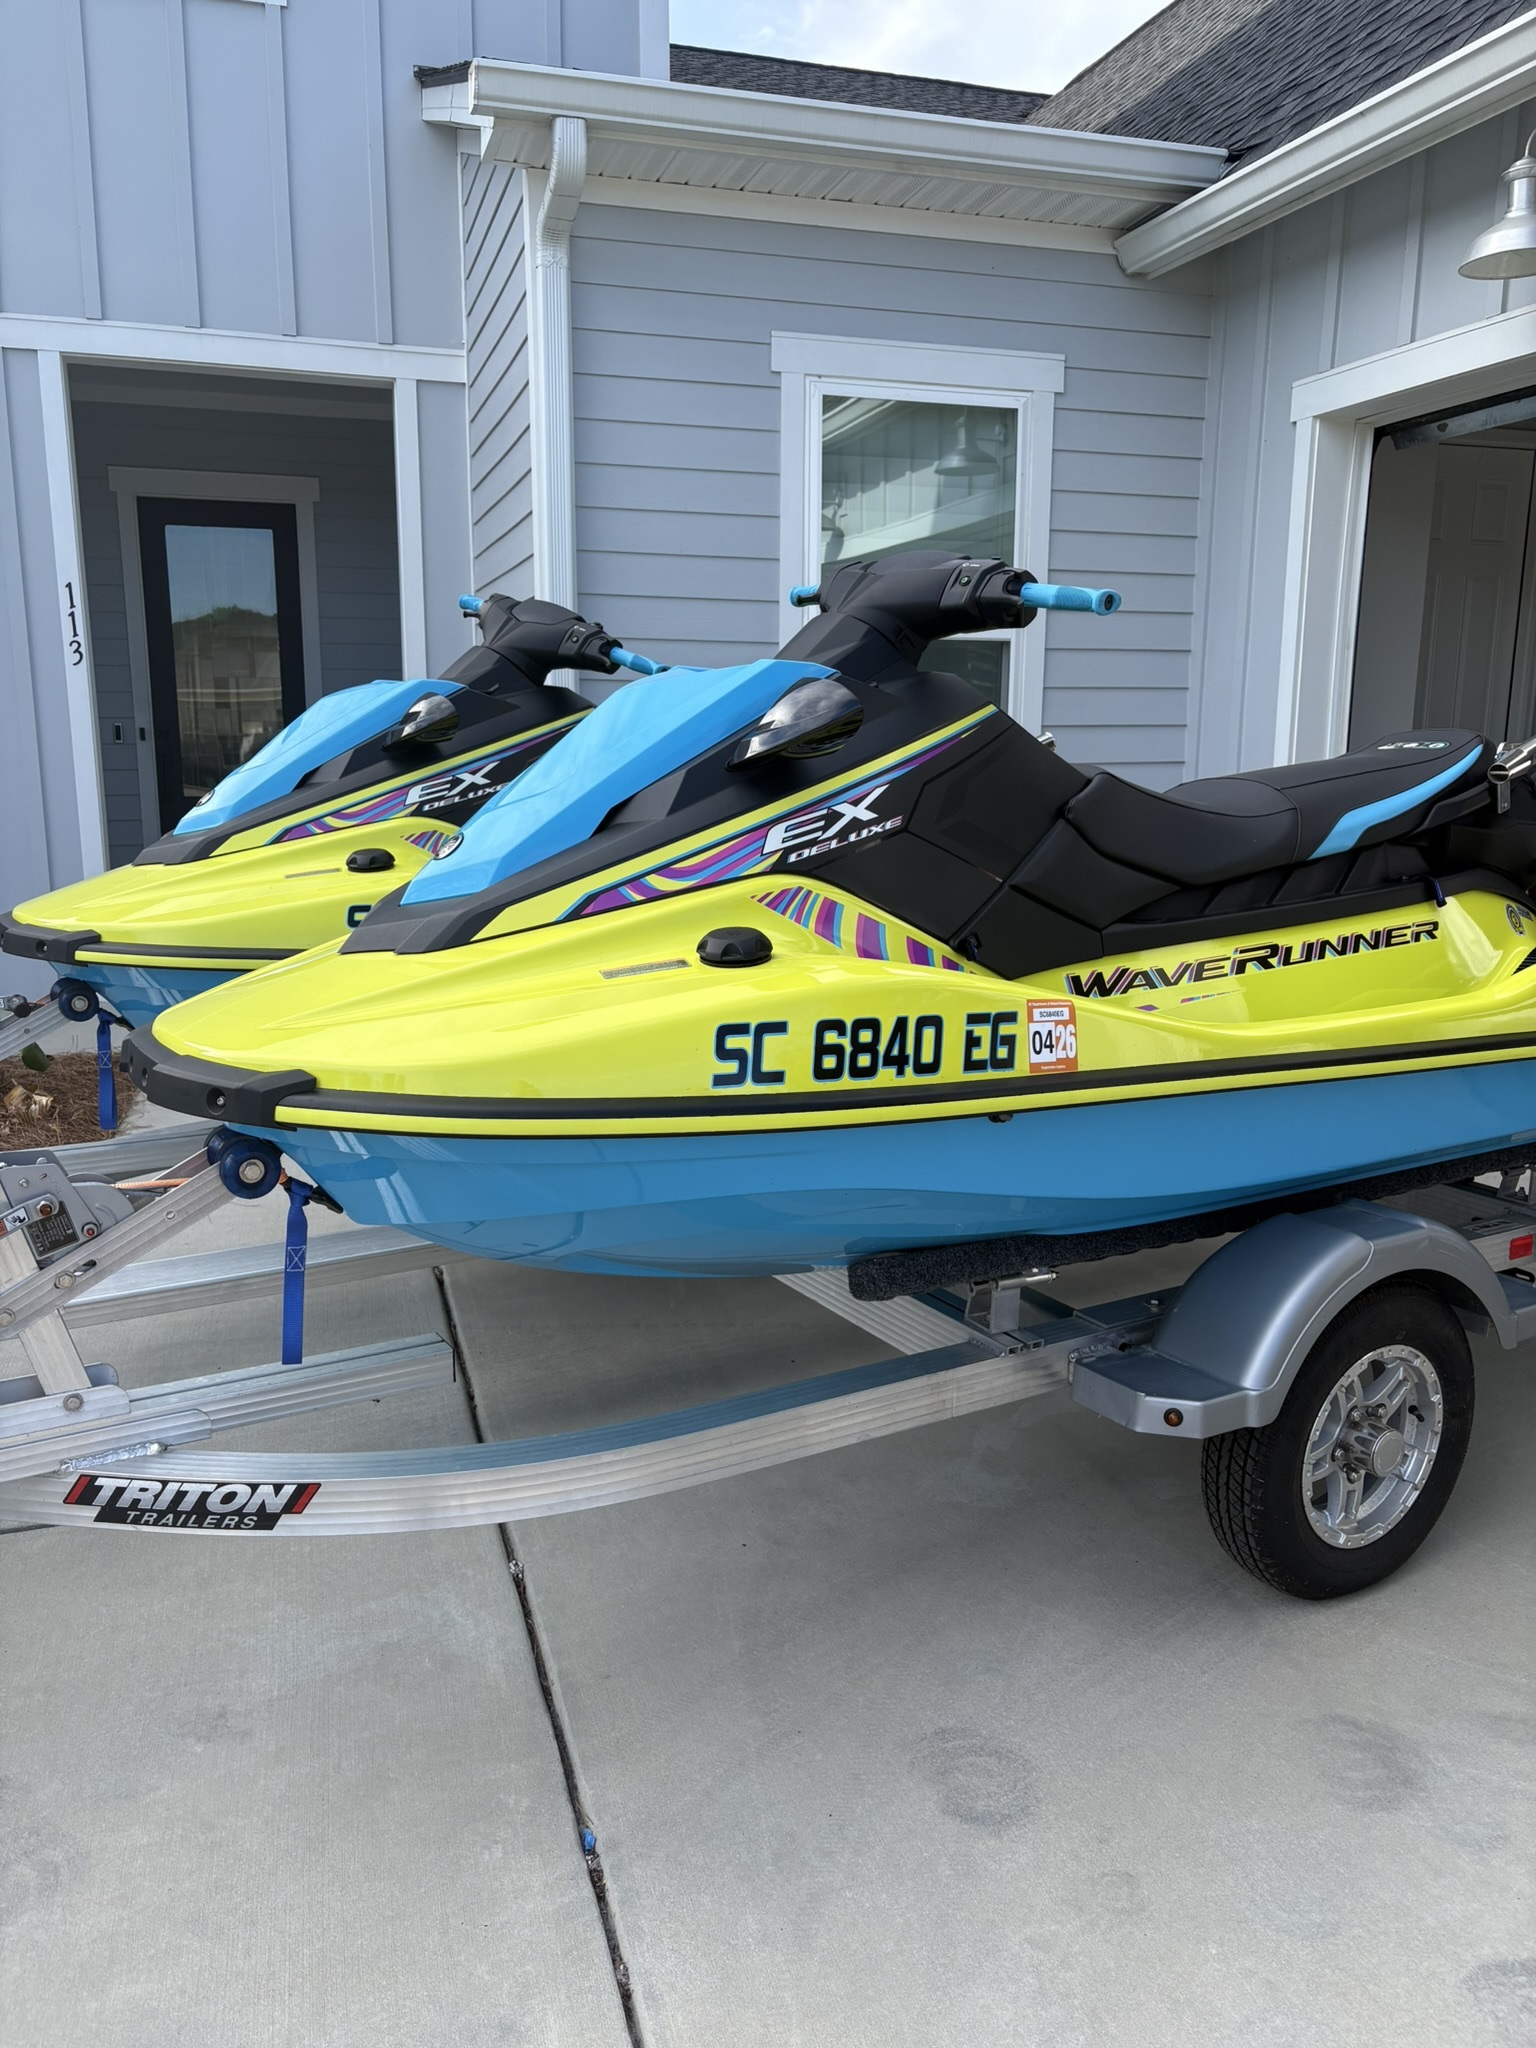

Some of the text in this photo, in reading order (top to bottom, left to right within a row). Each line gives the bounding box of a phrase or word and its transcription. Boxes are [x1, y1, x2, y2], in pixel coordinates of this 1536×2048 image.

[65, 582, 83, 666] 113
[405, 761, 500, 806] EX
[762, 783, 890, 855] EX
[787, 814, 904, 863] DELUXE
[711, 1011, 1018, 1088] SC 6840 EG
[1032, 1024, 1077, 1058] 04 26
[92, 1476, 297, 1513] TRITON
[126, 1511, 258, 1529] TRAILERS
